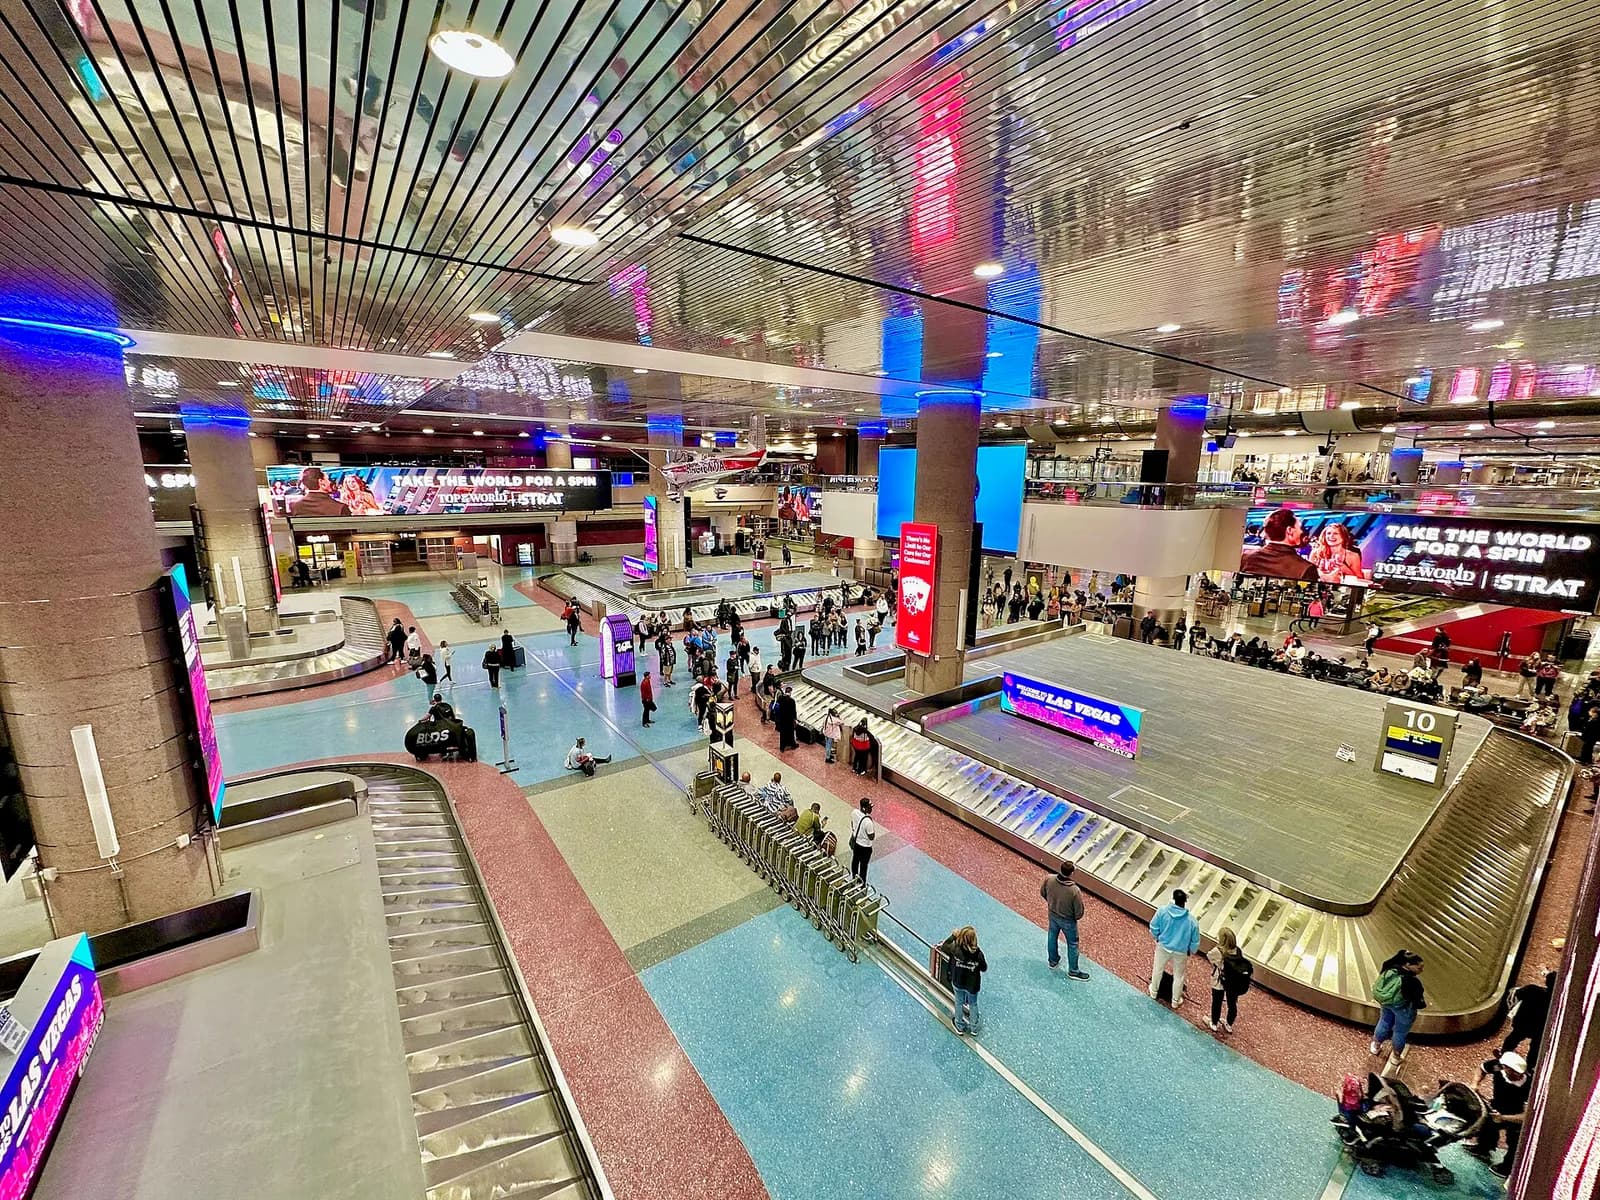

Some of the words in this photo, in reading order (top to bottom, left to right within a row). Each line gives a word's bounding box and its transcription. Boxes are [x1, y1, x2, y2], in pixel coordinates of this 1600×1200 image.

[161, 473, 197, 488] SPI
[391, 475, 428, 487] TAKE
[437, 475, 468, 487] THE
[473, 475, 523, 487] WORLD
[525, 475, 553, 487] FOR
[555, 475, 567, 487] A
[567, 475, 597, 487] SPIN
[438, 493, 461, 503] TOP
[470, 488, 508, 503] WORLD
[520, 492, 564, 506] STRAT
[1386, 525, 1439, 540] TAKE
[1445, 528, 1489, 544] THE
[1495, 530, 1592, 551] WORLD
[1413, 541, 1460, 557] FOR
[1464, 544, 1483, 559] A
[1486, 546, 1546, 564] SPIN
[1375, 562, 1406, 575] TOP
[1416, 562, 1476, 583] WORLD
[1497, 573, 1586, 598] STRAT
[1045, 693, 1074, 710] LAS
[1074, 702, 1122, 726] VEGAS
[1403, 710, 1436, 732] 10
[9, 1055, 42, 1134] LAS
[39, 974, 82, 1065] VEGAS
